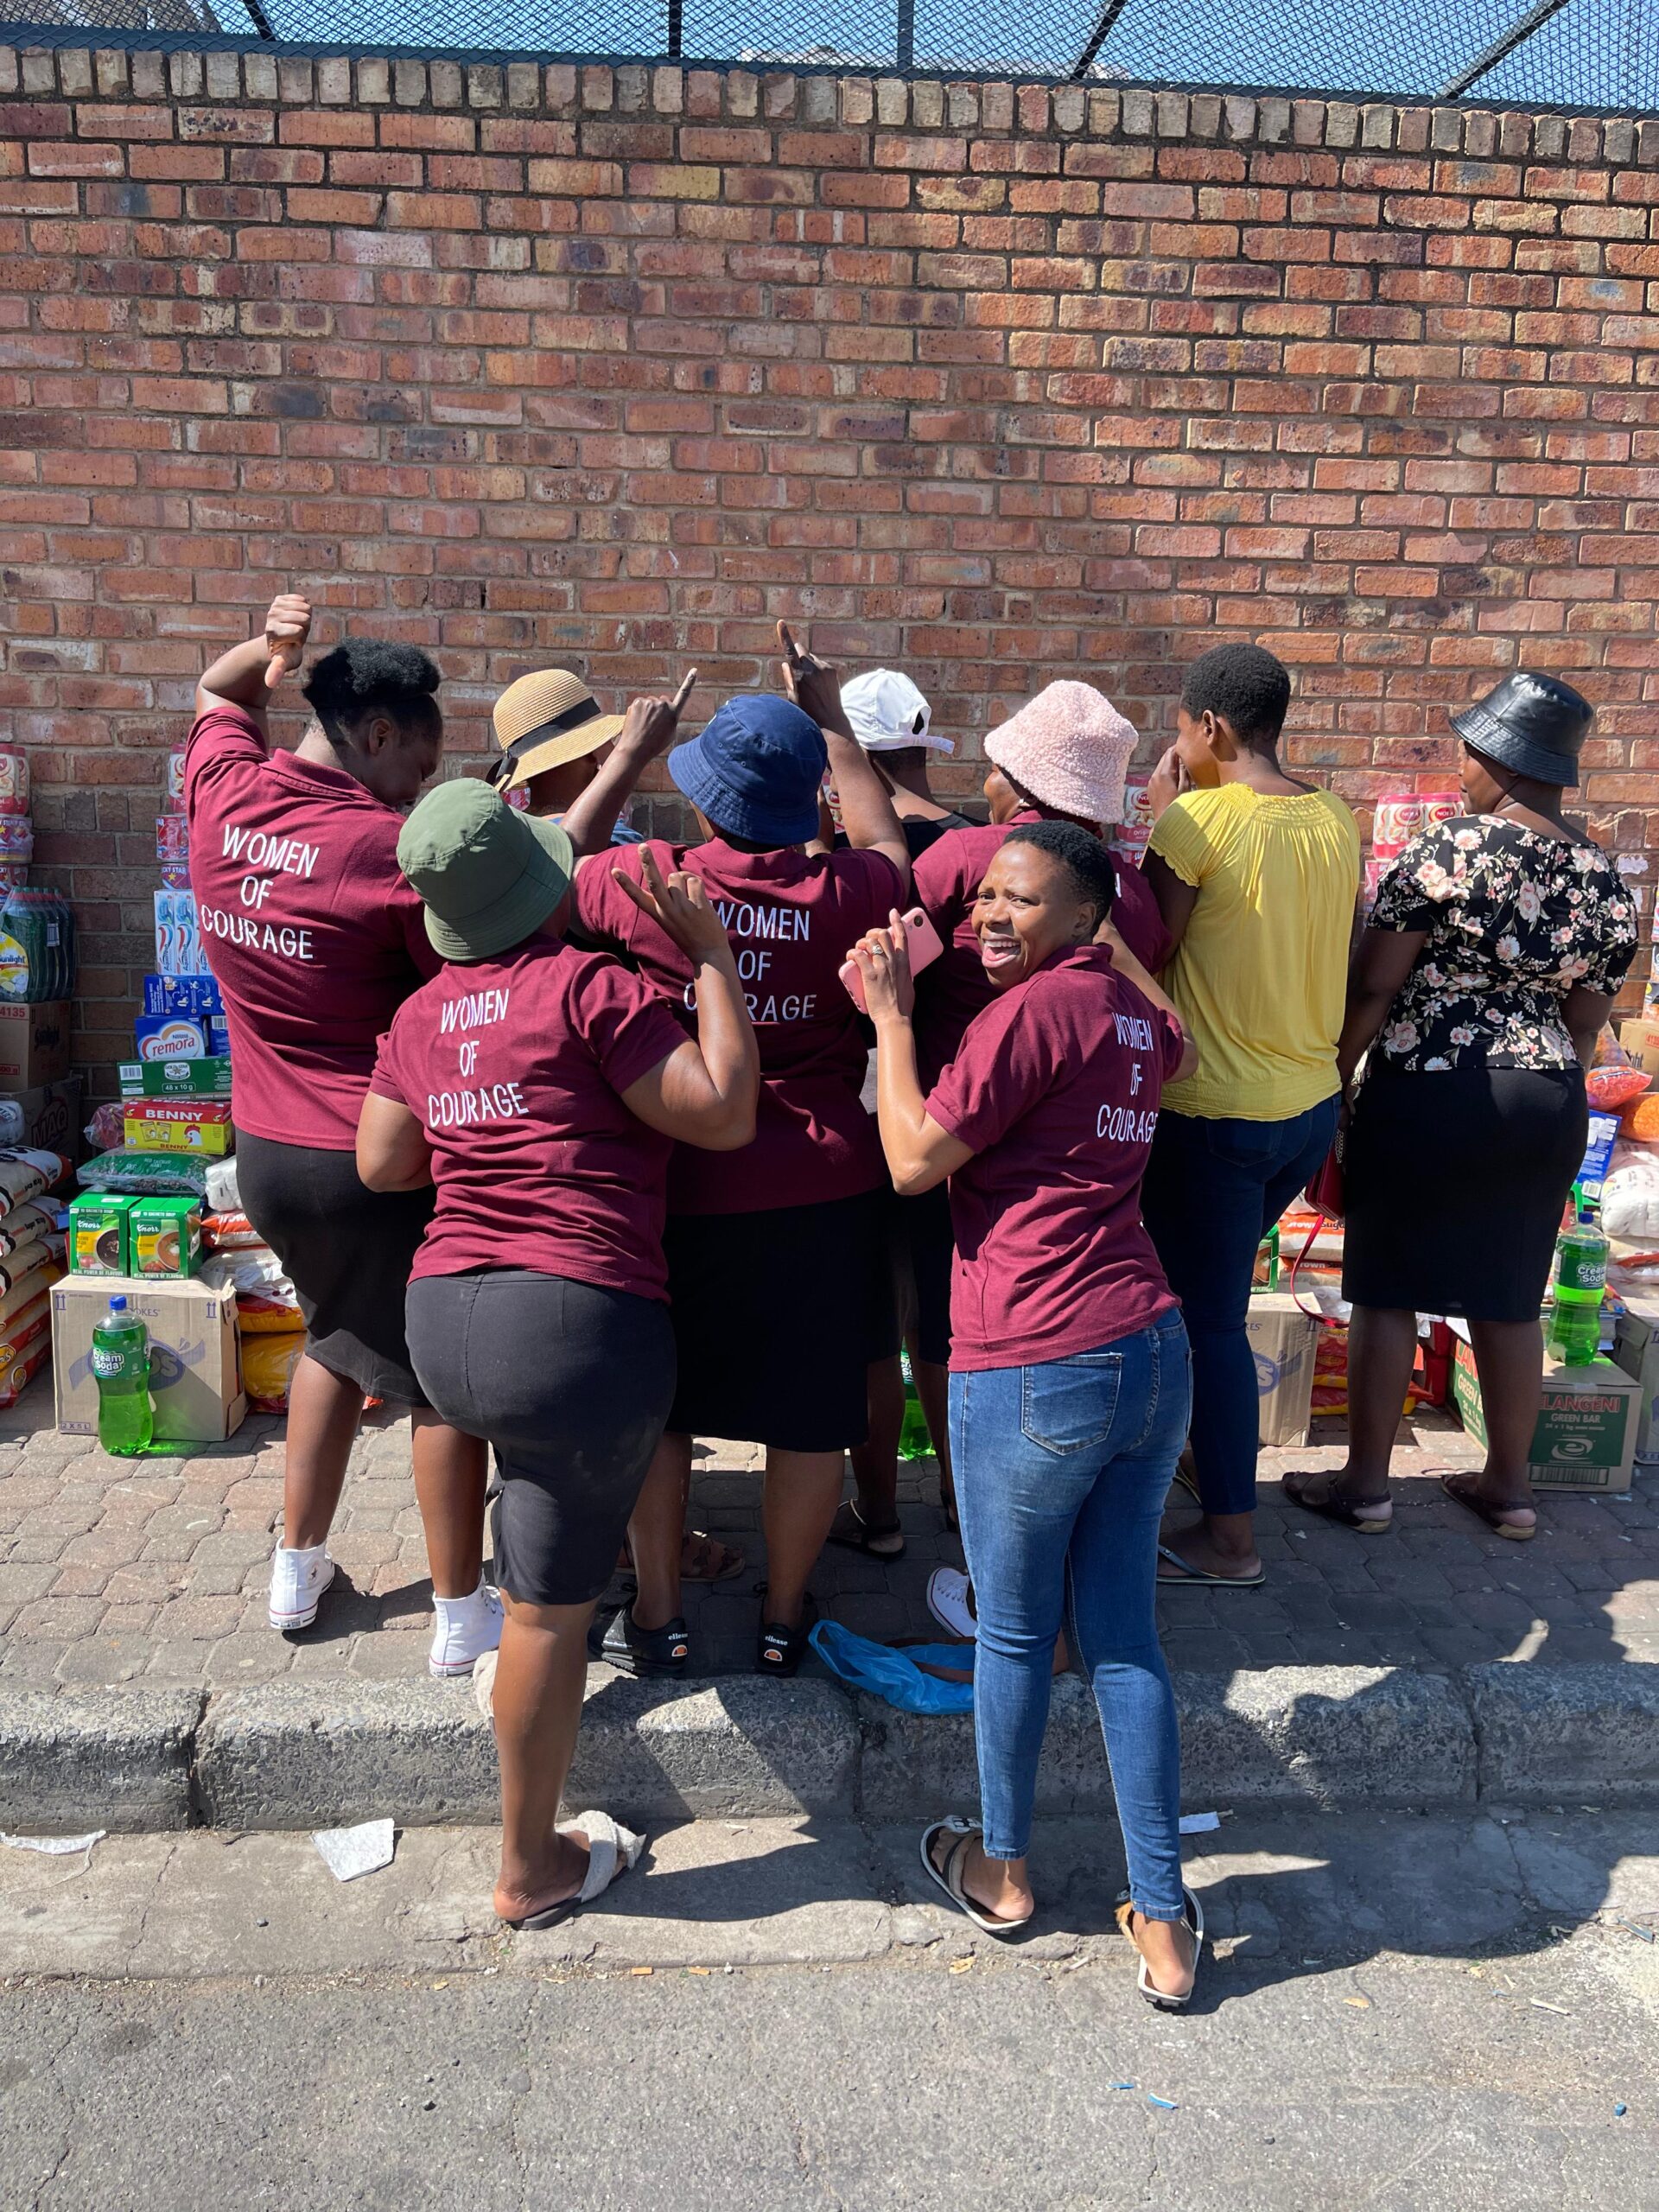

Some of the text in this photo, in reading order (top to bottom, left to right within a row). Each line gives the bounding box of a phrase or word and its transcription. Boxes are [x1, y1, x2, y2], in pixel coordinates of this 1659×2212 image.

[222, 823, 320, 878] WOMEN
[240, 875, 274, 909] OF
[200, 904, 314, 959] COURAGE
[0, 955, 26, 964] unlight
[738, 950, 772, 982] OF
[441, 988, 510, 1034] WOMEN
[683, 982, 817, 1022] CRAGE
[1111, 1012, 1154, 1052] WOMEN
[459, 1039, 480, 1077] OF
[1130, 1062, 1143, 1096] OF
[145, 1109, 204, 1122] BENNY
[428, 1082, 530, 1128] COURAGE
[77, 1220, 101, 1229] Knorr
[137, 1224, 160, 1232] Knorr
[95, 1360, 119, 1370] Soda
[1550, 1413, 1601, 1424] GREEN BAR
[765, 1635, 788, 1646] ellesse
